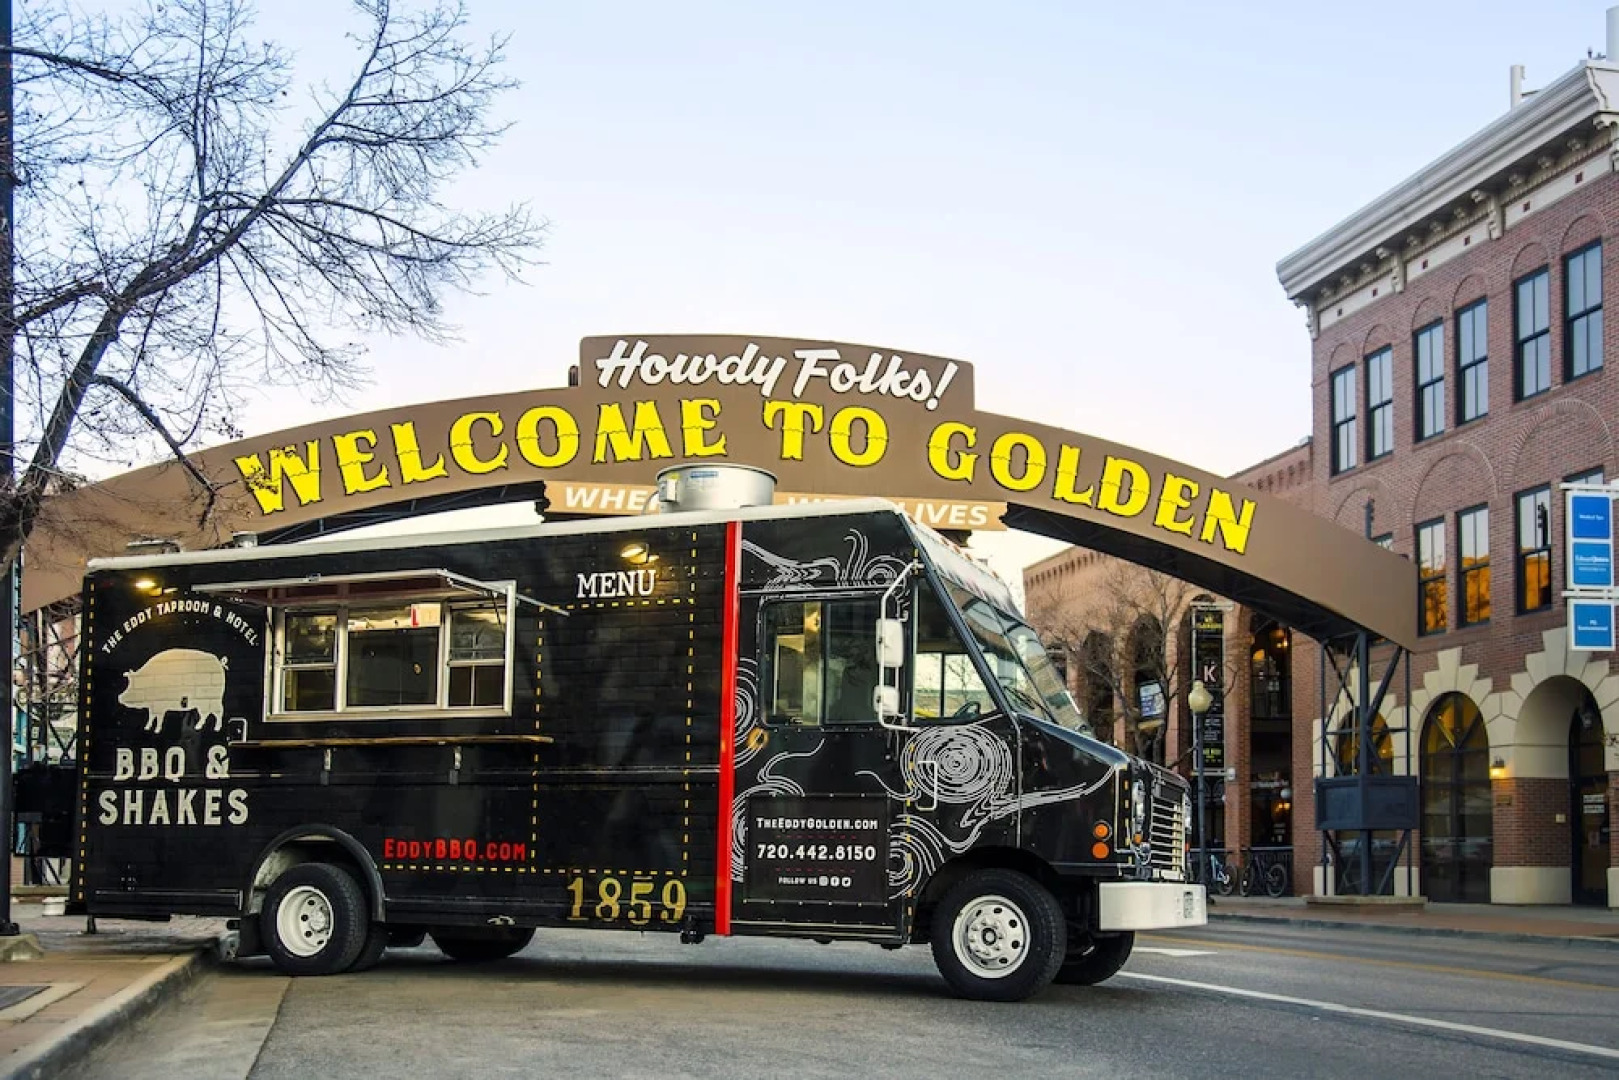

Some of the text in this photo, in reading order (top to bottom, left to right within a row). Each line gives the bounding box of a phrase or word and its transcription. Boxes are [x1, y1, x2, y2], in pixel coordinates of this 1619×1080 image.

[595, 339, 959, 410] Howdy Folks!
[233, 398, 1258, 555] WELCOME TO GOLDEN
[901, 502, 989, 526] IVES
[576, 569, 657, 599] MENU
[101, 599, 257, 654] THE EDDY TAPROOM & HOTEL
[113, 745, 230, 782] BBQ &
[98, 789, 249, 825] SHAKES
[756, 844, 877, 861] 720.442.8150
[778, 877, 818, 885] FOLLOW US
[566, 876, 688, 926] 1859
